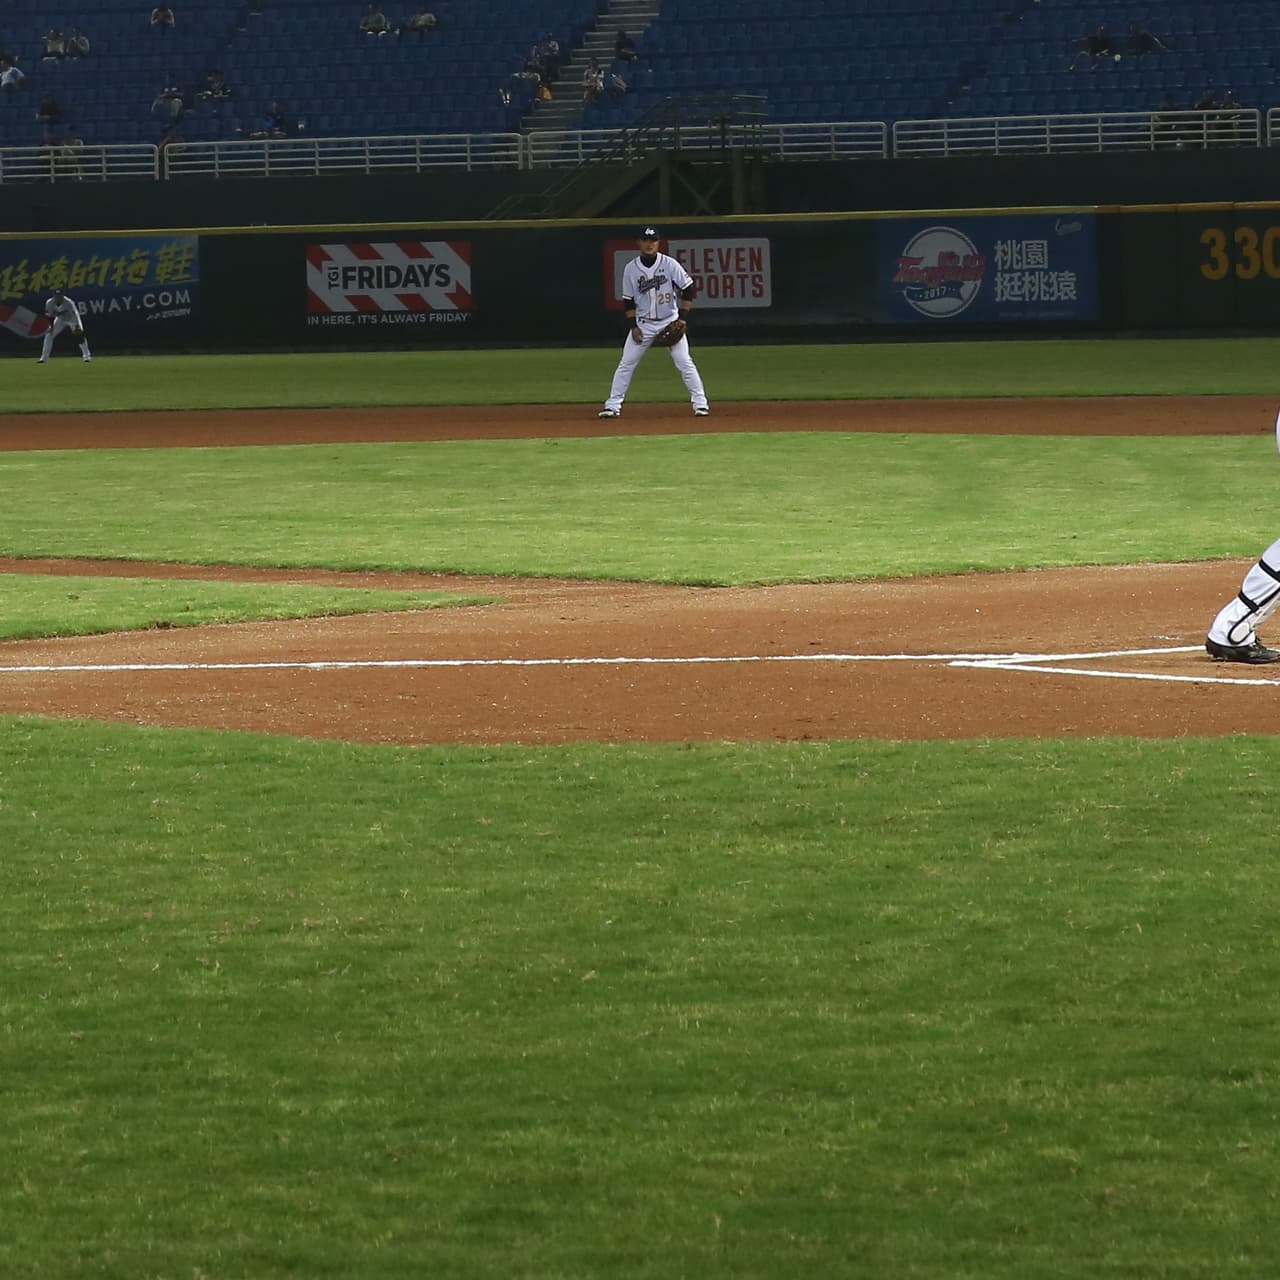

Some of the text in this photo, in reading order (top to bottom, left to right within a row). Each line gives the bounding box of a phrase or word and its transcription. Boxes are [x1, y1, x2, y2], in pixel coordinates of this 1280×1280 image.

[676, 247, 762, 274] ELEVEN
[993, 239, 1049, 270] 桃園
[327, 263, 451, 290] TGI FRIDAYS
[680, 274, 764, 299] PORTS
[993, 270, 1078, 302] 挺桃猿
[657, 292, 671, 305] 29
[924, 286, 947, 299] 2017
[307, 316, 319, 326] IN
[358, 314, 377, 325] IT'S
[380, 313, 425, 324] ALWAYS
[429, 312, 469, 323] FRIDAY
